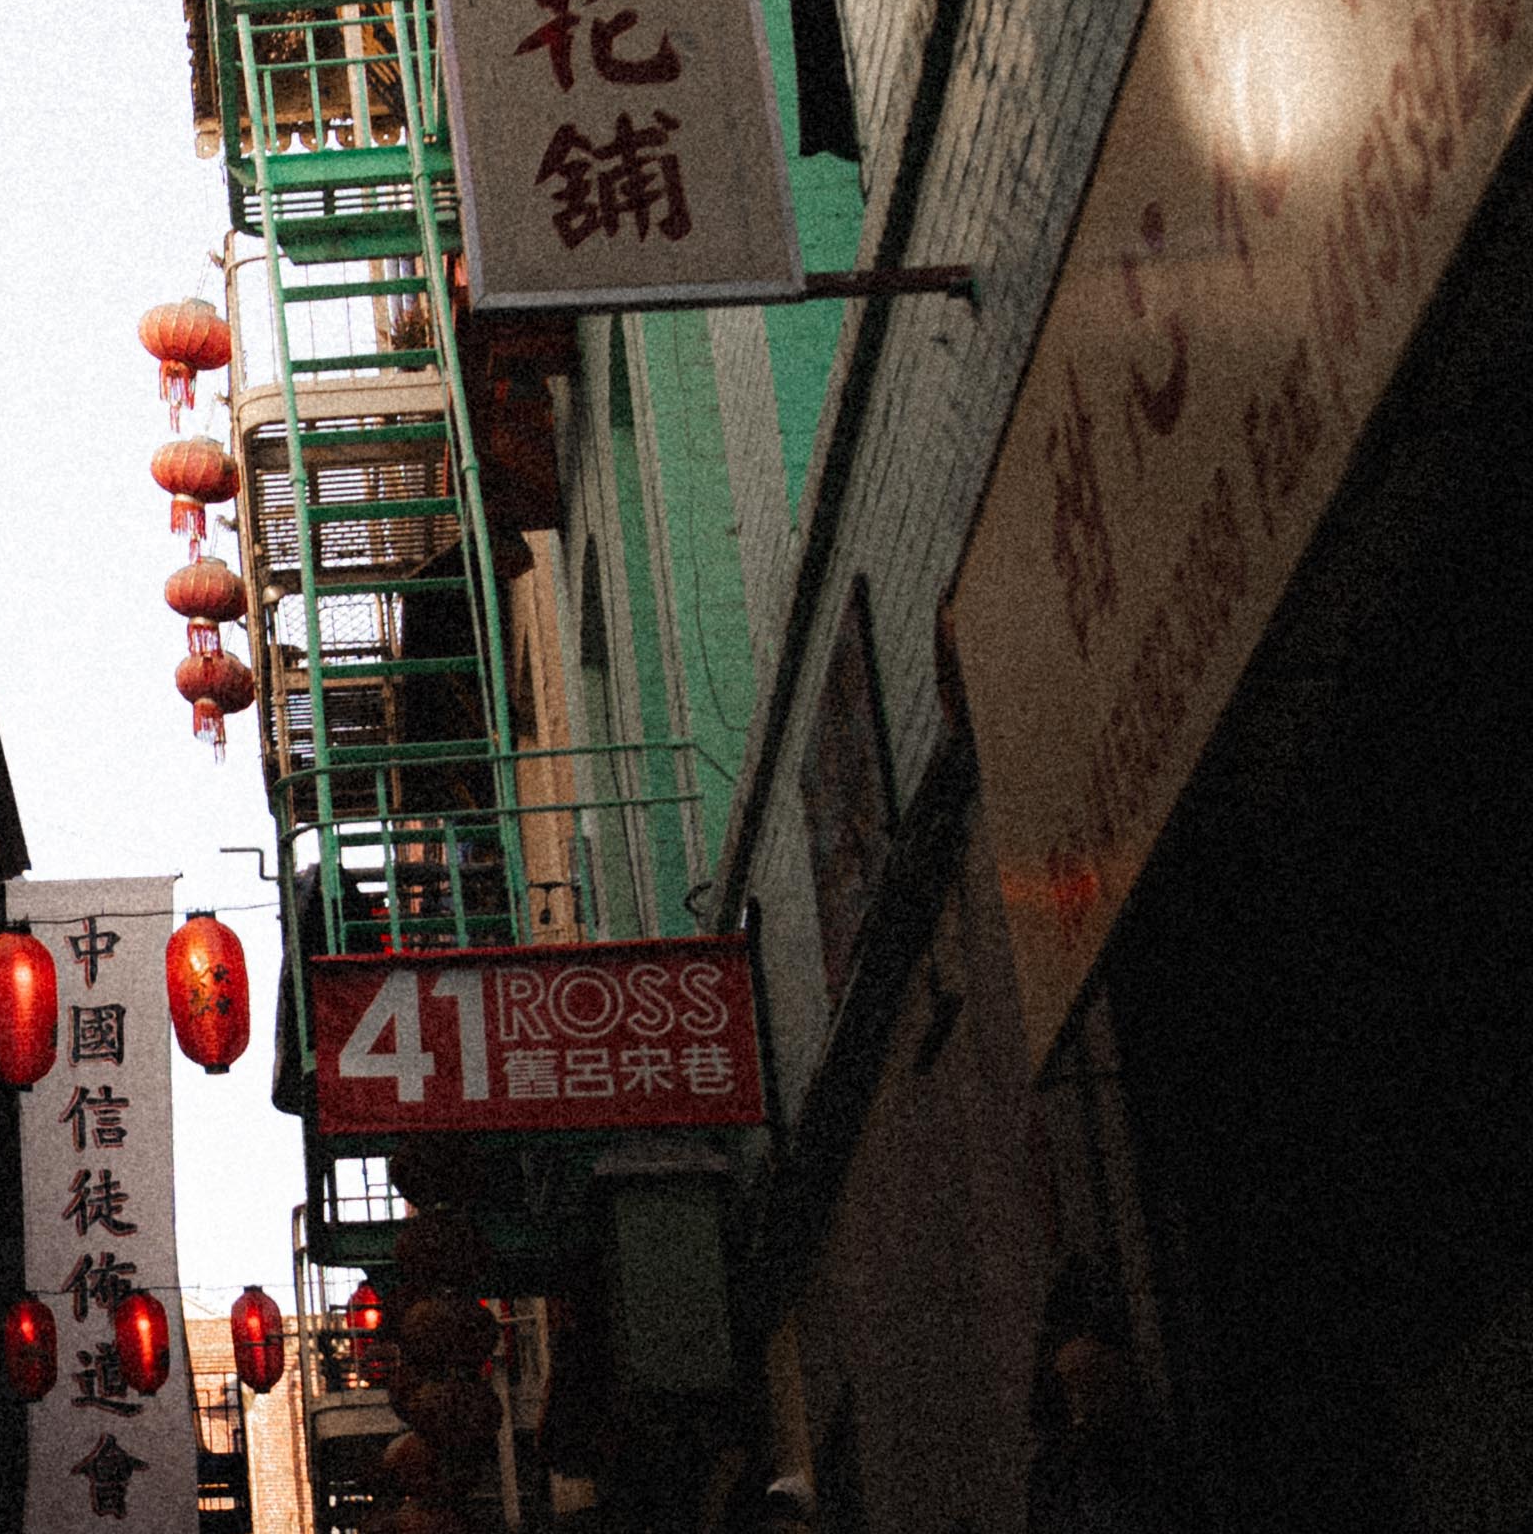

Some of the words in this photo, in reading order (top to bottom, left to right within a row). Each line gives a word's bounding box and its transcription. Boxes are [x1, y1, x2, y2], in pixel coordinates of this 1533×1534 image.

[337, 968, 492, 1104] 41
[493, 962, 730, 1042] ROSS
[501, 1042, 735, 1101] 舊呂宋巷
[59, 914, 150, 1521] 中國信徒佈道會
